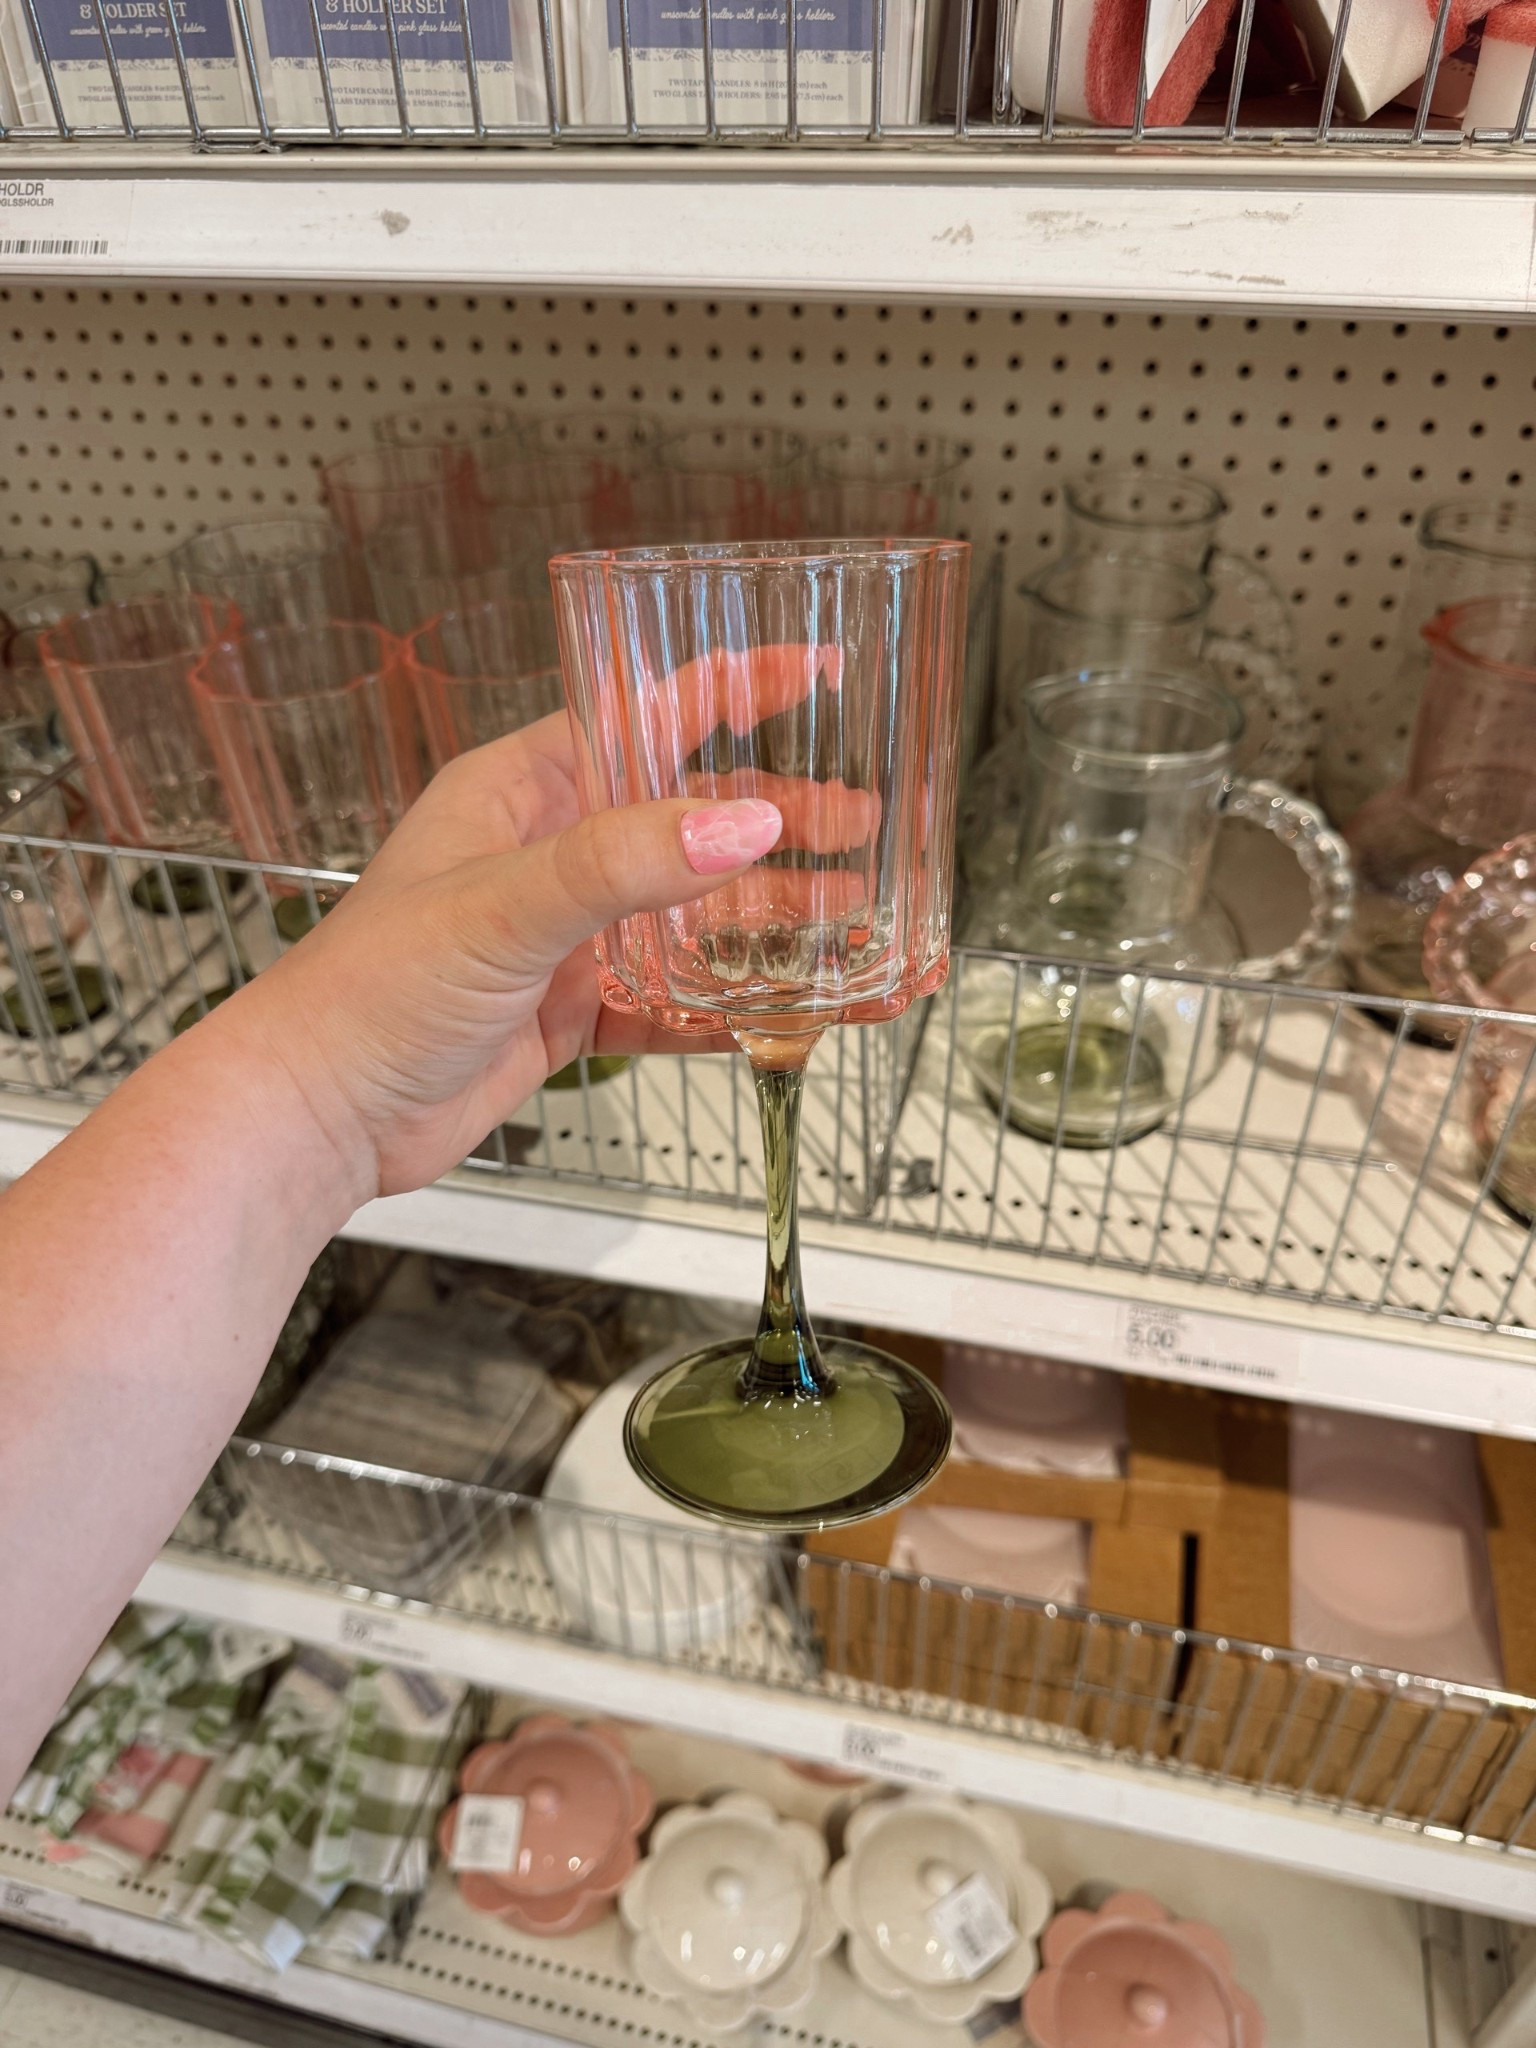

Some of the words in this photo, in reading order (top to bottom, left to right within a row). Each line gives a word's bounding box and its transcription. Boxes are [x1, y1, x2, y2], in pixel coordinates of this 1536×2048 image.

[80, 4, 91, 19] &
[100, 3, 158, 18] OLDER
[416, 0, 446, 14] SET
[661, 7, 702, 19] unscented
[736, 7, 754, 19] with
[757, 8, 778, 24] pink
[805, 8, 836, 20] holders
[350, 19, 378, 31] candles
[398, 20, 416, 35] pink
[418, 20, 438, 36] glass
